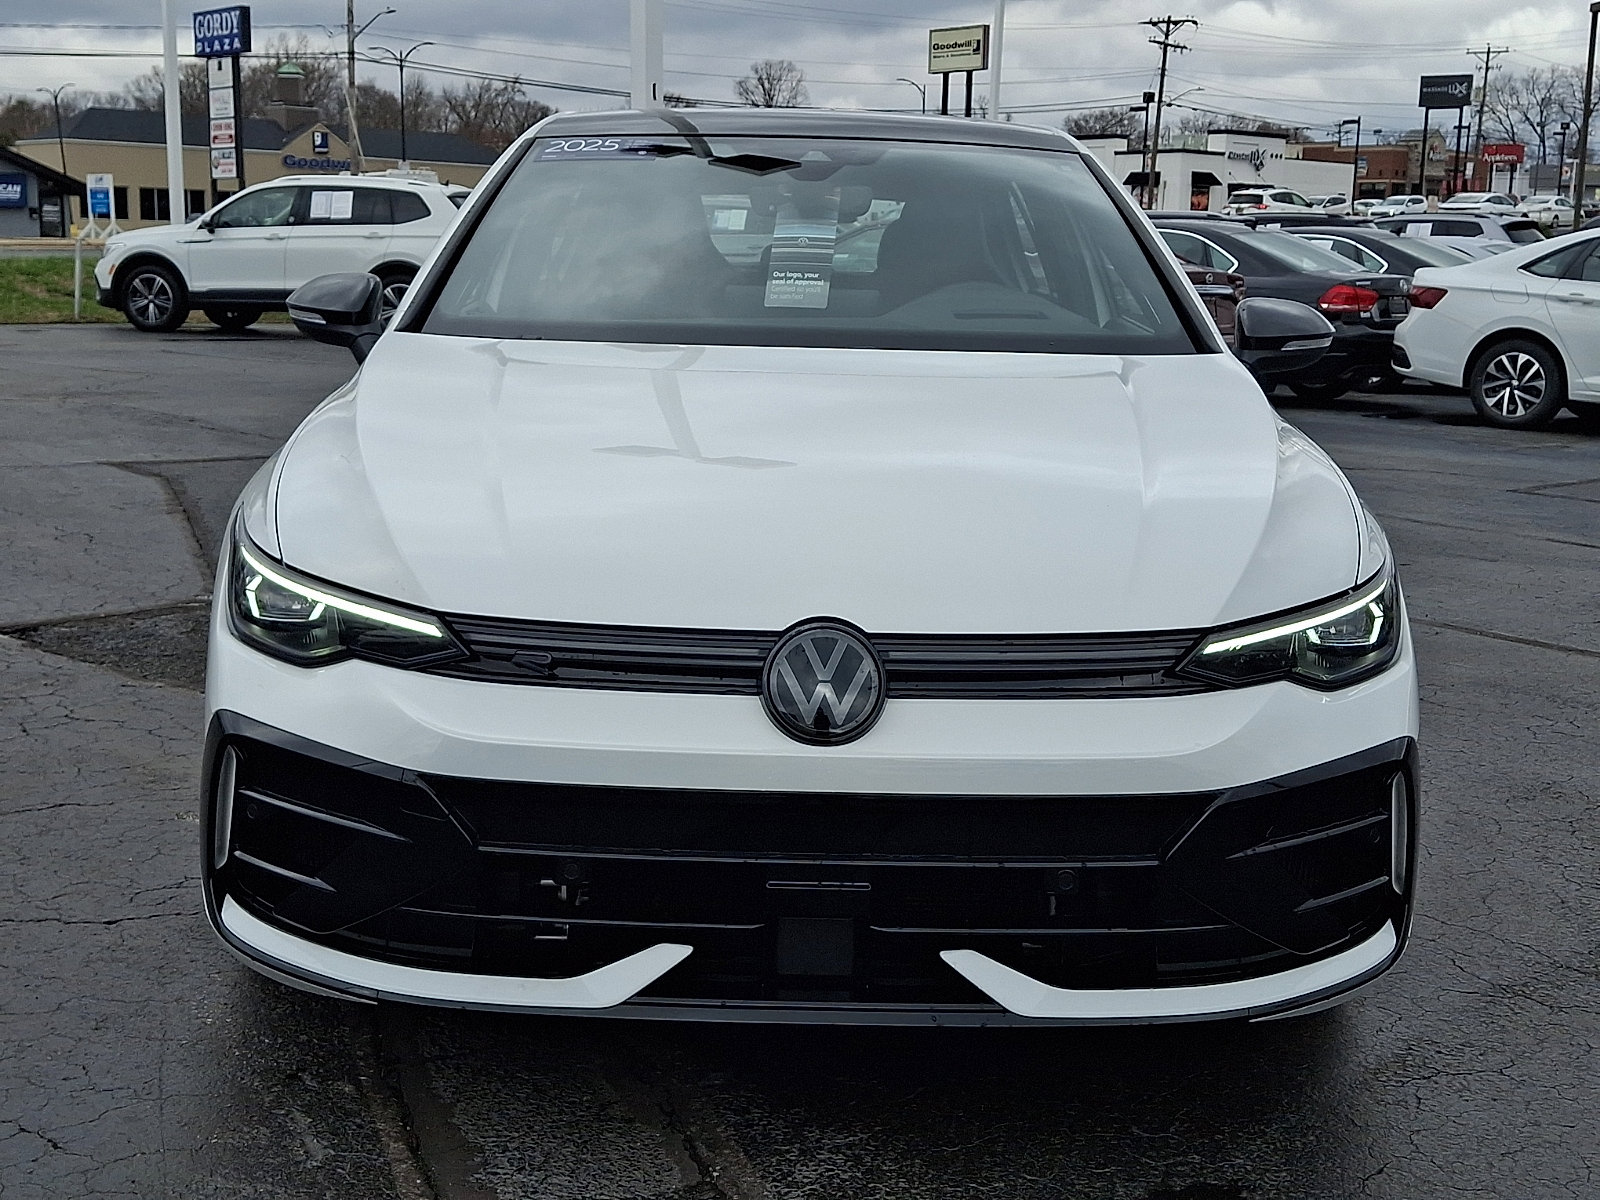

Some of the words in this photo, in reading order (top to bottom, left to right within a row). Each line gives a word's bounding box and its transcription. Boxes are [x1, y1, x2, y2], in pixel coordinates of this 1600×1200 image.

[196, 11, 240, 39] GORDY
[196, 37, 242, 53] PLAZA
[932, 40, 972, 51] Goodwill
[545, 139, 622, 152] 2025
[284, 155, 351, 168] Goodwi
